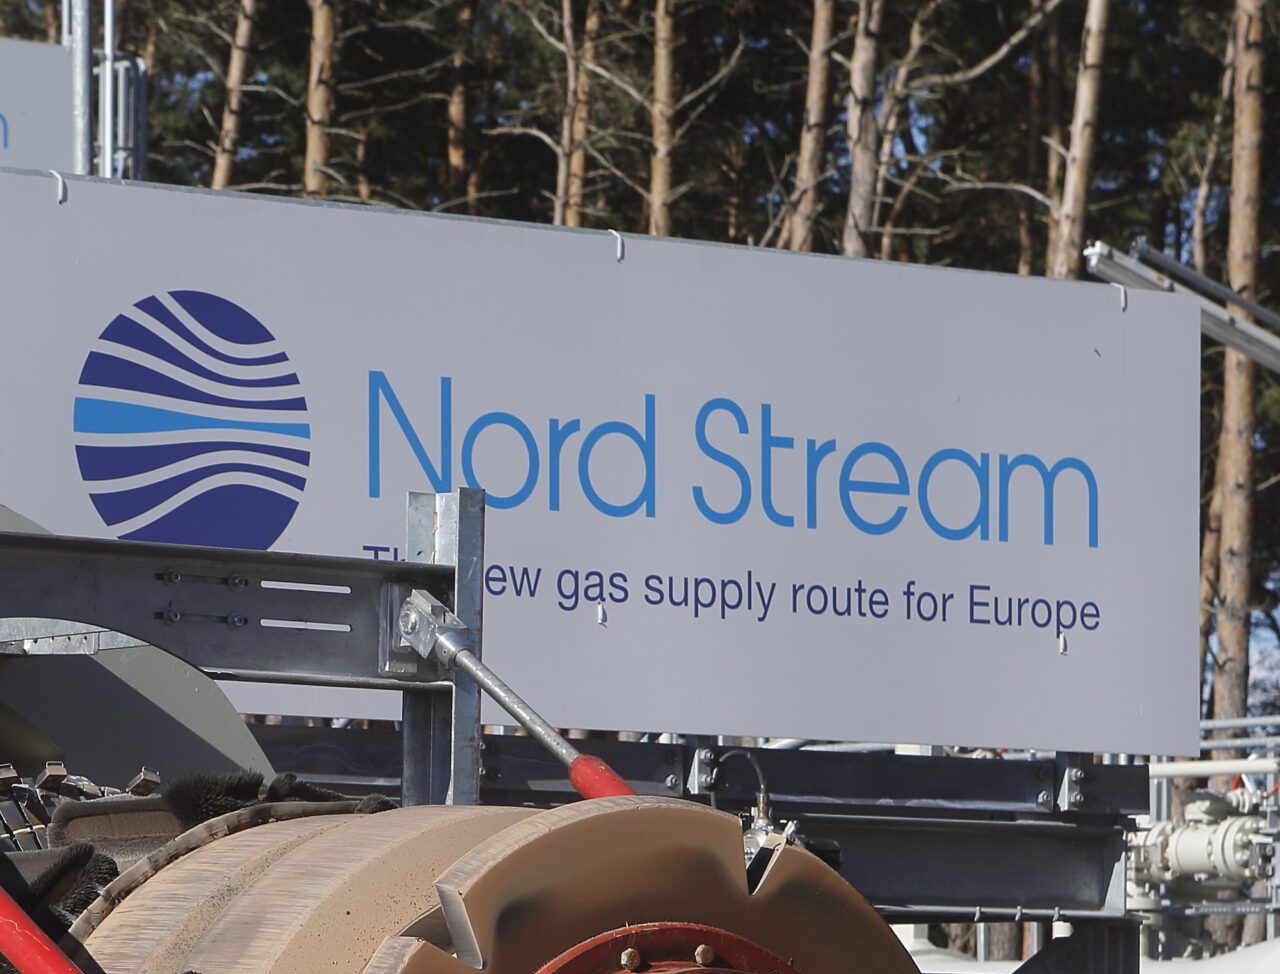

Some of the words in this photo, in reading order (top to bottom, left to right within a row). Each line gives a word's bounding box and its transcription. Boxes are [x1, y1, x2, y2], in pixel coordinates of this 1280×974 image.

[368, 370, 656, 519] Nord
[692, 397, 1099, 549] Stream
[485, 563, 542, 598] ew
[557, 568, 629, 611] gas
[644, 570, 776, 622] supply
[792, 579, 890, 618] route
[903, 581, 954, 622] for
[969, 584, 1101, 639] Europe
